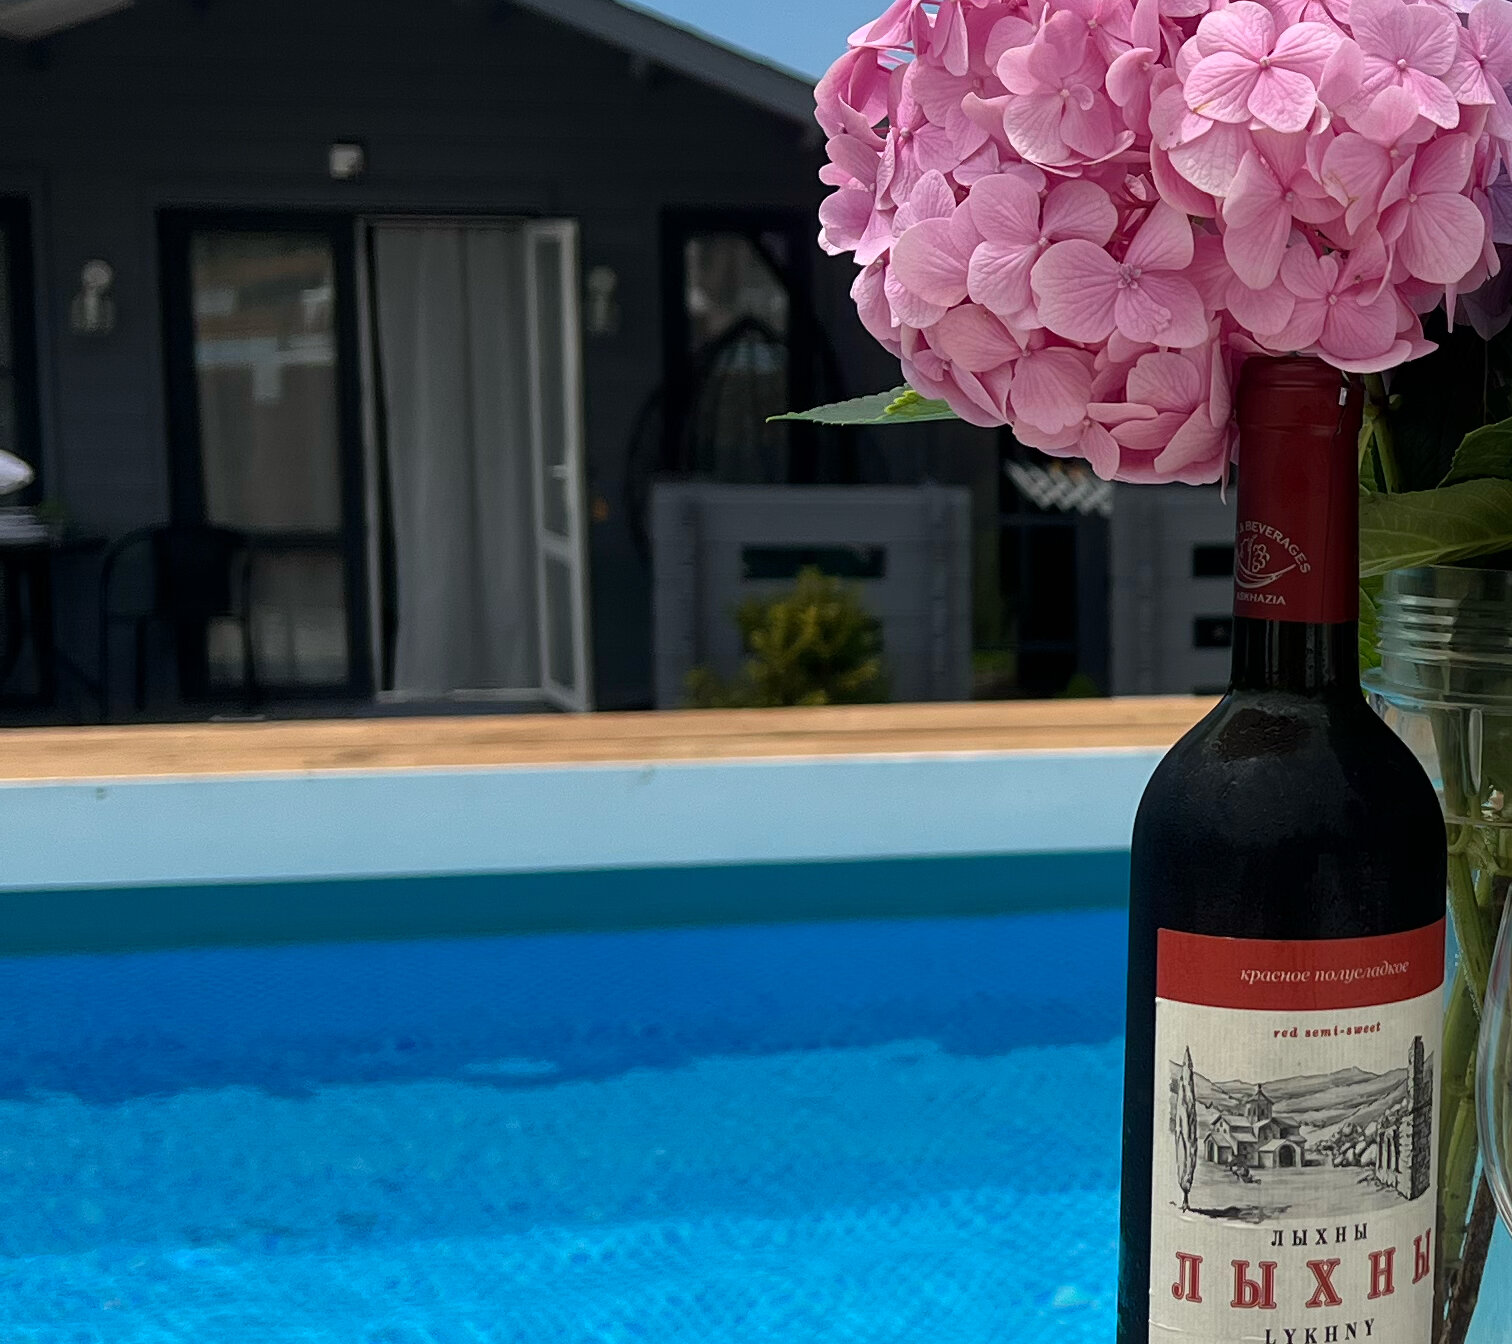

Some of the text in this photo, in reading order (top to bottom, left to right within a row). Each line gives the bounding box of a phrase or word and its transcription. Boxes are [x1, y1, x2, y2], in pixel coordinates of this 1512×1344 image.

[1245, 520, 1312, 574] BEVERAGES
[1240, 960, 1409, 985] красное полусладкое
[1273, 1021, 1381, 1038] red semi-sweet
[1270, 1223, 1368, 1247] ЛЫХНЫ
[1171, 1227, 1432, 1310] ЛЫХНЫ
